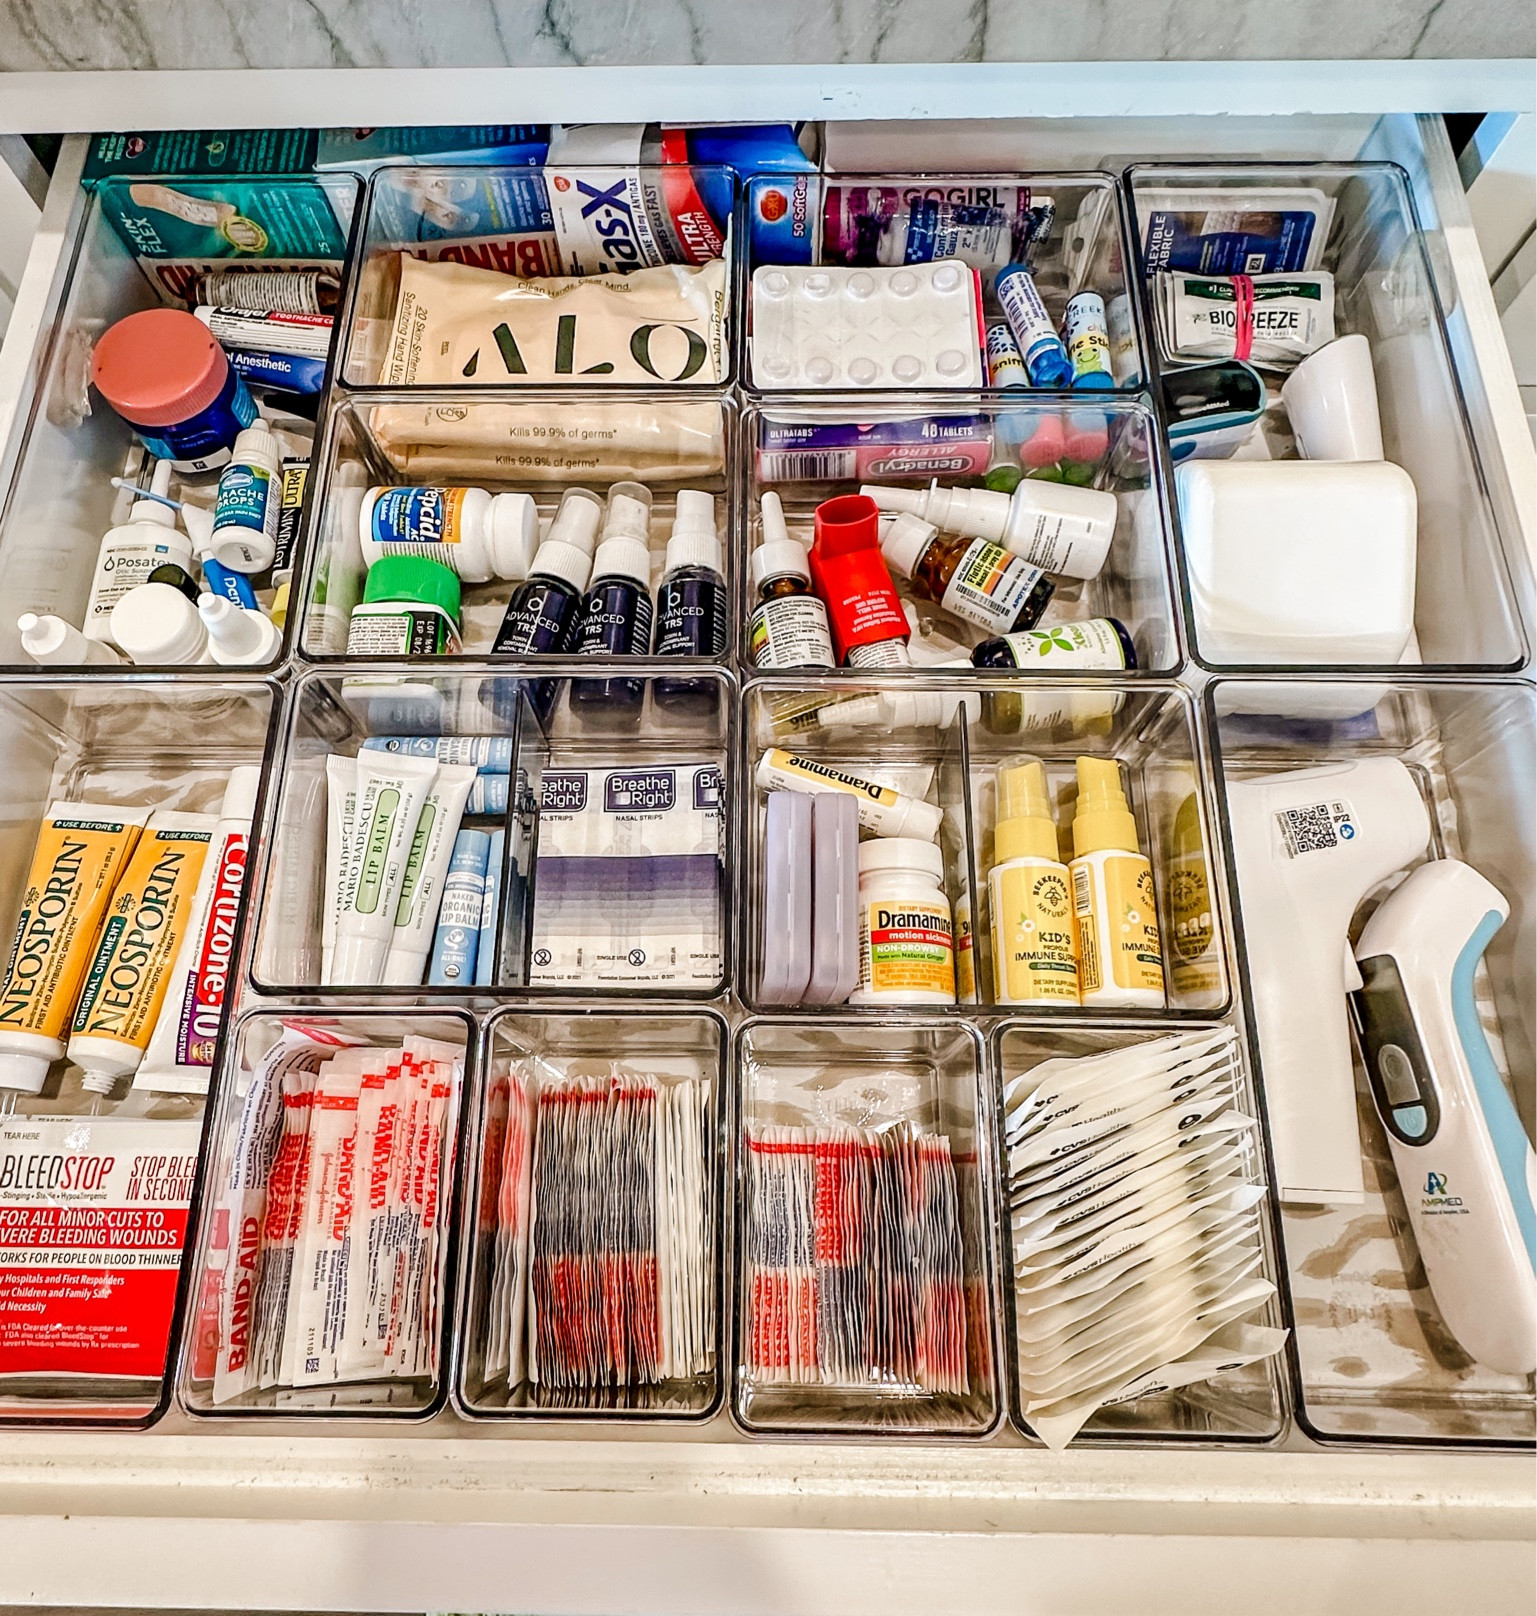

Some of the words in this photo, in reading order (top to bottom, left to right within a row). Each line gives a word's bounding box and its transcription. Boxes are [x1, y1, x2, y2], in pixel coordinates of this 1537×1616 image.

[540, 211, 553, 225] 30
[133, 217, 168, 253] FLEX
[677, 212, 713, 262] ULTRA
[1157, 228, 1175, 272] FABRIC
[220, 306, 269, 318] Orajel
[274, 311, 324, 324] TOOTHACHE
[1209, 310, 1300, 330] BIOREEZE
[235, 353, 292, 373] Anesthetic
[509, 427, 531, 438] Kills
[533, 427, 566, 439] 99.9%
[568, 426, 580, 439] of
[770, 427, 813, 439] ULTRATABS
[938, 426, 974, 438] TABLETS
[887, 445, 958, 457] ALLERGY
[495, 455, 516, 466] Kills
[518, 456, 551, 467] 99.9%
[553, 457, 565, 468] of
[878, 457, 964, 474] Benadryl
[216, 496, 255, 511] DROPS
[410, 528, 420, 542] AC
[116, 557, 169, 568] Posate
[426, 620, 435, 635] LOT
[505, 611, 560, 633] ADVANCED
[516, 621, 537, 634] TRS
[664, 617, 683, 630] TRS
[585, 625, 603, 636] TRS
[612, 776, 670, 792] Breathe
[788, 754, 884, 800] Dramamine
[541, 780, 582, 793] eathe
[542, 791, 582, 808] Right
[631, 790, 671, 807] Right
[549, 815, 574, 823] STRIPS
[615, 814, 639, 823] NASAL
[639, 814, 664, 822] STRIPS
[1332, 813, 1352, 824] IP22
[62, 821, 80, 829] USE
[79, 822, 115, 832] BEFORE
[165, 832, 179, 840] USE
[179, 833, 211, 842] BEFORE
[372, 814, 390, 854] BALM
[408, 829, 426, 868] BALM
[343, 866, 359, 912] MARIO
[352, 802, 373, 863] BADESCU
[365, 860, 380, 885] LIP
[388, 867, 397, 881] ALL
[423, 881, 432, 895] ALL
[443, 902, 480, 916] ORGANIC
[440, 913, 454, 924] LIP
[455, 915, 479, 927] BALM
[0, 840, 88, 1028] NEOSPORIN
[889, 931, 925, 941] motion
[1038, 931, 1071, 945] KID'S
[88, 851, 186, 1036] NEOSPORIN
[876, 944, 940, 954] NON-DROWSY
[901, 952, 926, 960] Natural
[926, 953, 945, 962] Ginger
[1015, 951, 1057, 963] IMMUNE
[47, 953, 67, 995] ANTIBIOTIC
[76, 976, 101, 1027] ORIGINAL
[94, 921, 123, 975] OINTMENT
[43, 994, 53, 1009] AID
[128, 1020, 144, 1041] FIRST
[139, 1006, 149, 1021] AID
[145, 965, 164, 1007] ANTIBIOTIC
[184, 974, 197, 1020] INTENSIVE
[34, 1009, 48, 1030] FIRST
[177, 1020, 189, 1063] MOISTURE
[3, 1132, 22, 1141] TEAR
[22, 1132, 41, 1141] HERE
[1, 1154, 115, 1191] BLEEDSTOP
[130, 1155, 166, 1178] STOP
[60, 1191, 108, 1201] Hypoallergenic
[125, 1178, 142, 1201] IN
[143, 1178, 195, 1201] SECOND
[0, 1210, 29, 1227] FOR
[30, 1210, 56, 1227] ALL
[57, 1211, 105, 1227] MINOR
[107, 1211, 143, 1228] CUTS
[145, 1211, 165, 1228] TO
[0, 1227, 37, 1244] VERE
[38, 1227, 107, 1245] BLEEDING
[109, 1229, 178, 1246] WOUNDS
[0, 1251, 27, 1264] ORKS
[28, 1252, 49, 1264] FOR
[51, 1252, 87, 1264] PEOPLE
[87, 1253, 102, 1264] ON
[103, 1253, 137, 1265] BLOOD
[5, 1274, 44, 1286] Hospitals
[44, 1274, 62, 1284] and
[62, 1274, 80, 1285] First
[80, 1275, 126, 1287] Responders
[11, 1287, 48, 1298] Children
[48, 1288, 65, 1298] and
[65, 1288, 93, 1301] Family
[226, 1217, 260, 1374] BAND-AID
[7, 1301, 47, 1314] Necessity
[7, 1323, 22, 1331] FDA
[22, 1323, 50, 1332] Cleared
[100, 1341, 140, 1350] prescription
